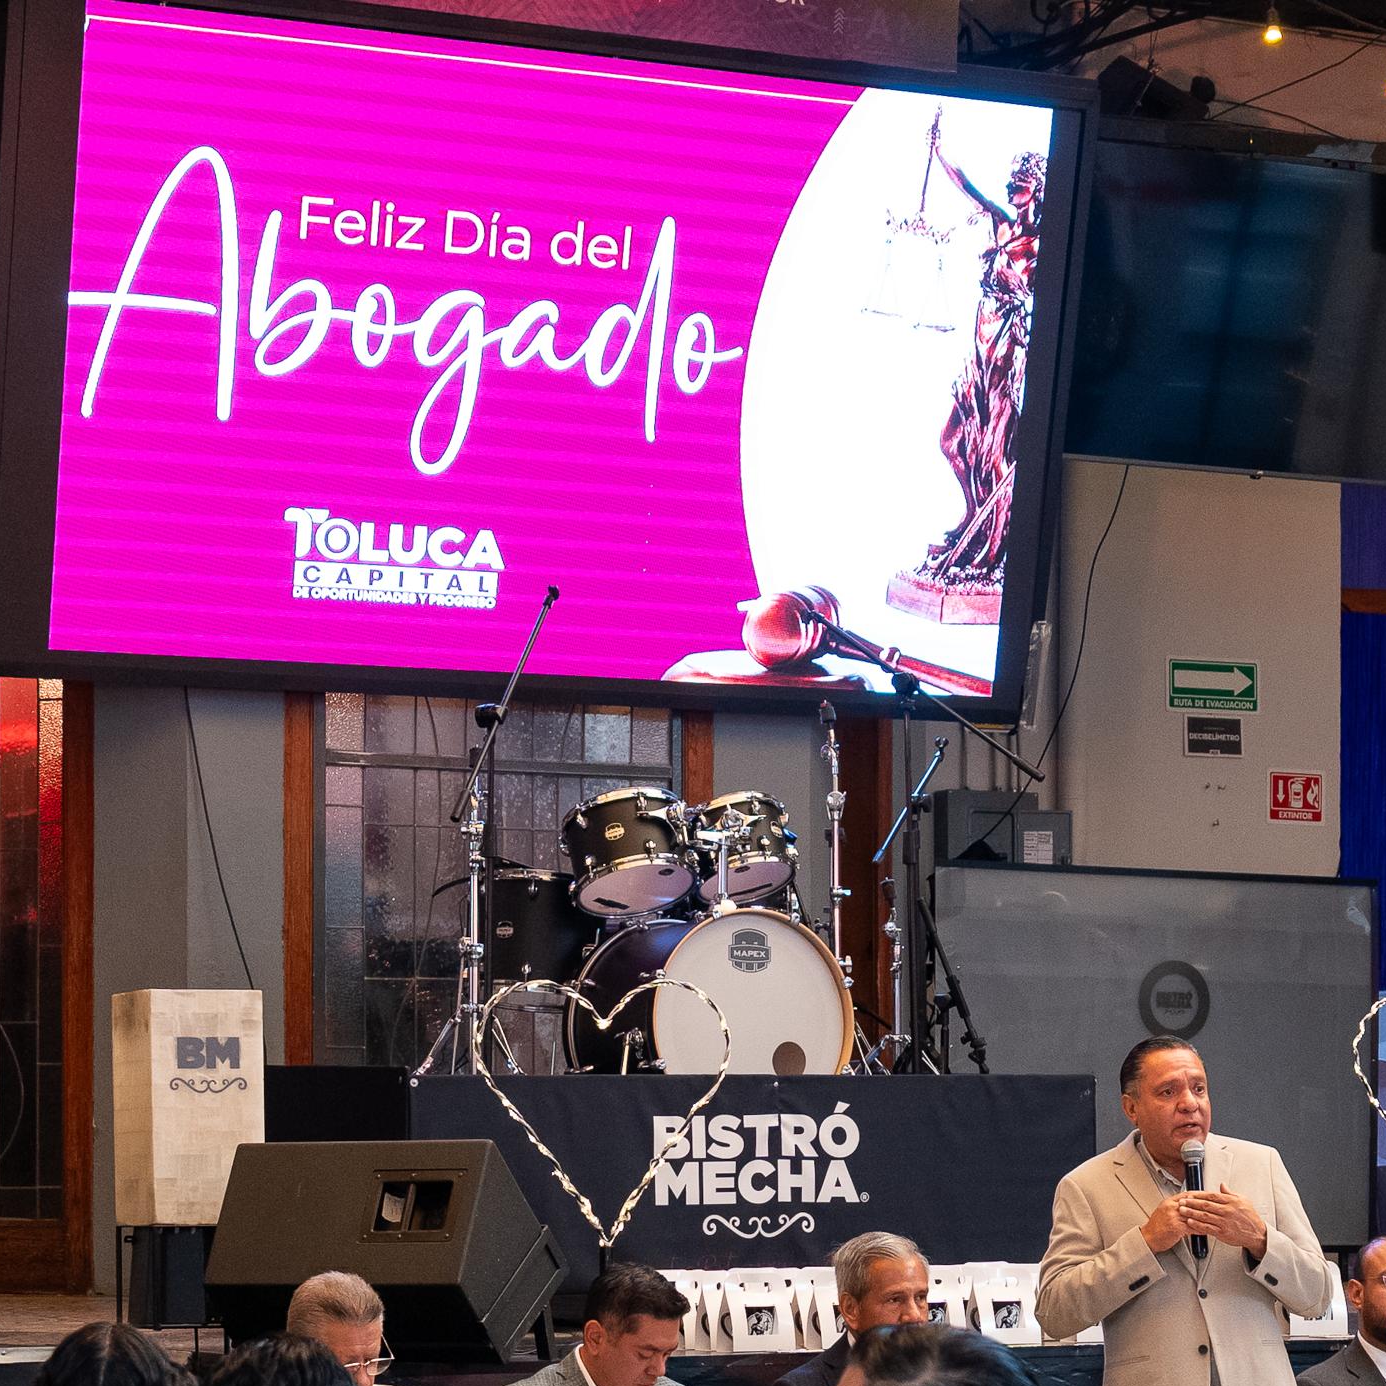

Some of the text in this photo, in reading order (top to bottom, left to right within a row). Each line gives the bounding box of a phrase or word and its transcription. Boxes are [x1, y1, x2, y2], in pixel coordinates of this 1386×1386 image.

[298, 194, 634, 271] Feliz Día del
[67, 145, 745, 477] Abogado
[283, 506, 507, 571] TOLUCA
[301, 564, 491, 593] CAPITAL
[292, 586, 498, 609] DE OPORTUNIDADES Y PROGRESO
[1173, 698, 1254, 710] RUTA DE EVACUACION
[1278, 811, 1314, 821] EXTINTOR
[733, 949, 767, 959] MAPEX
[176, 1036, 241, 1070] BM
[653, 1101, 861, 1160] BISTRÓ
